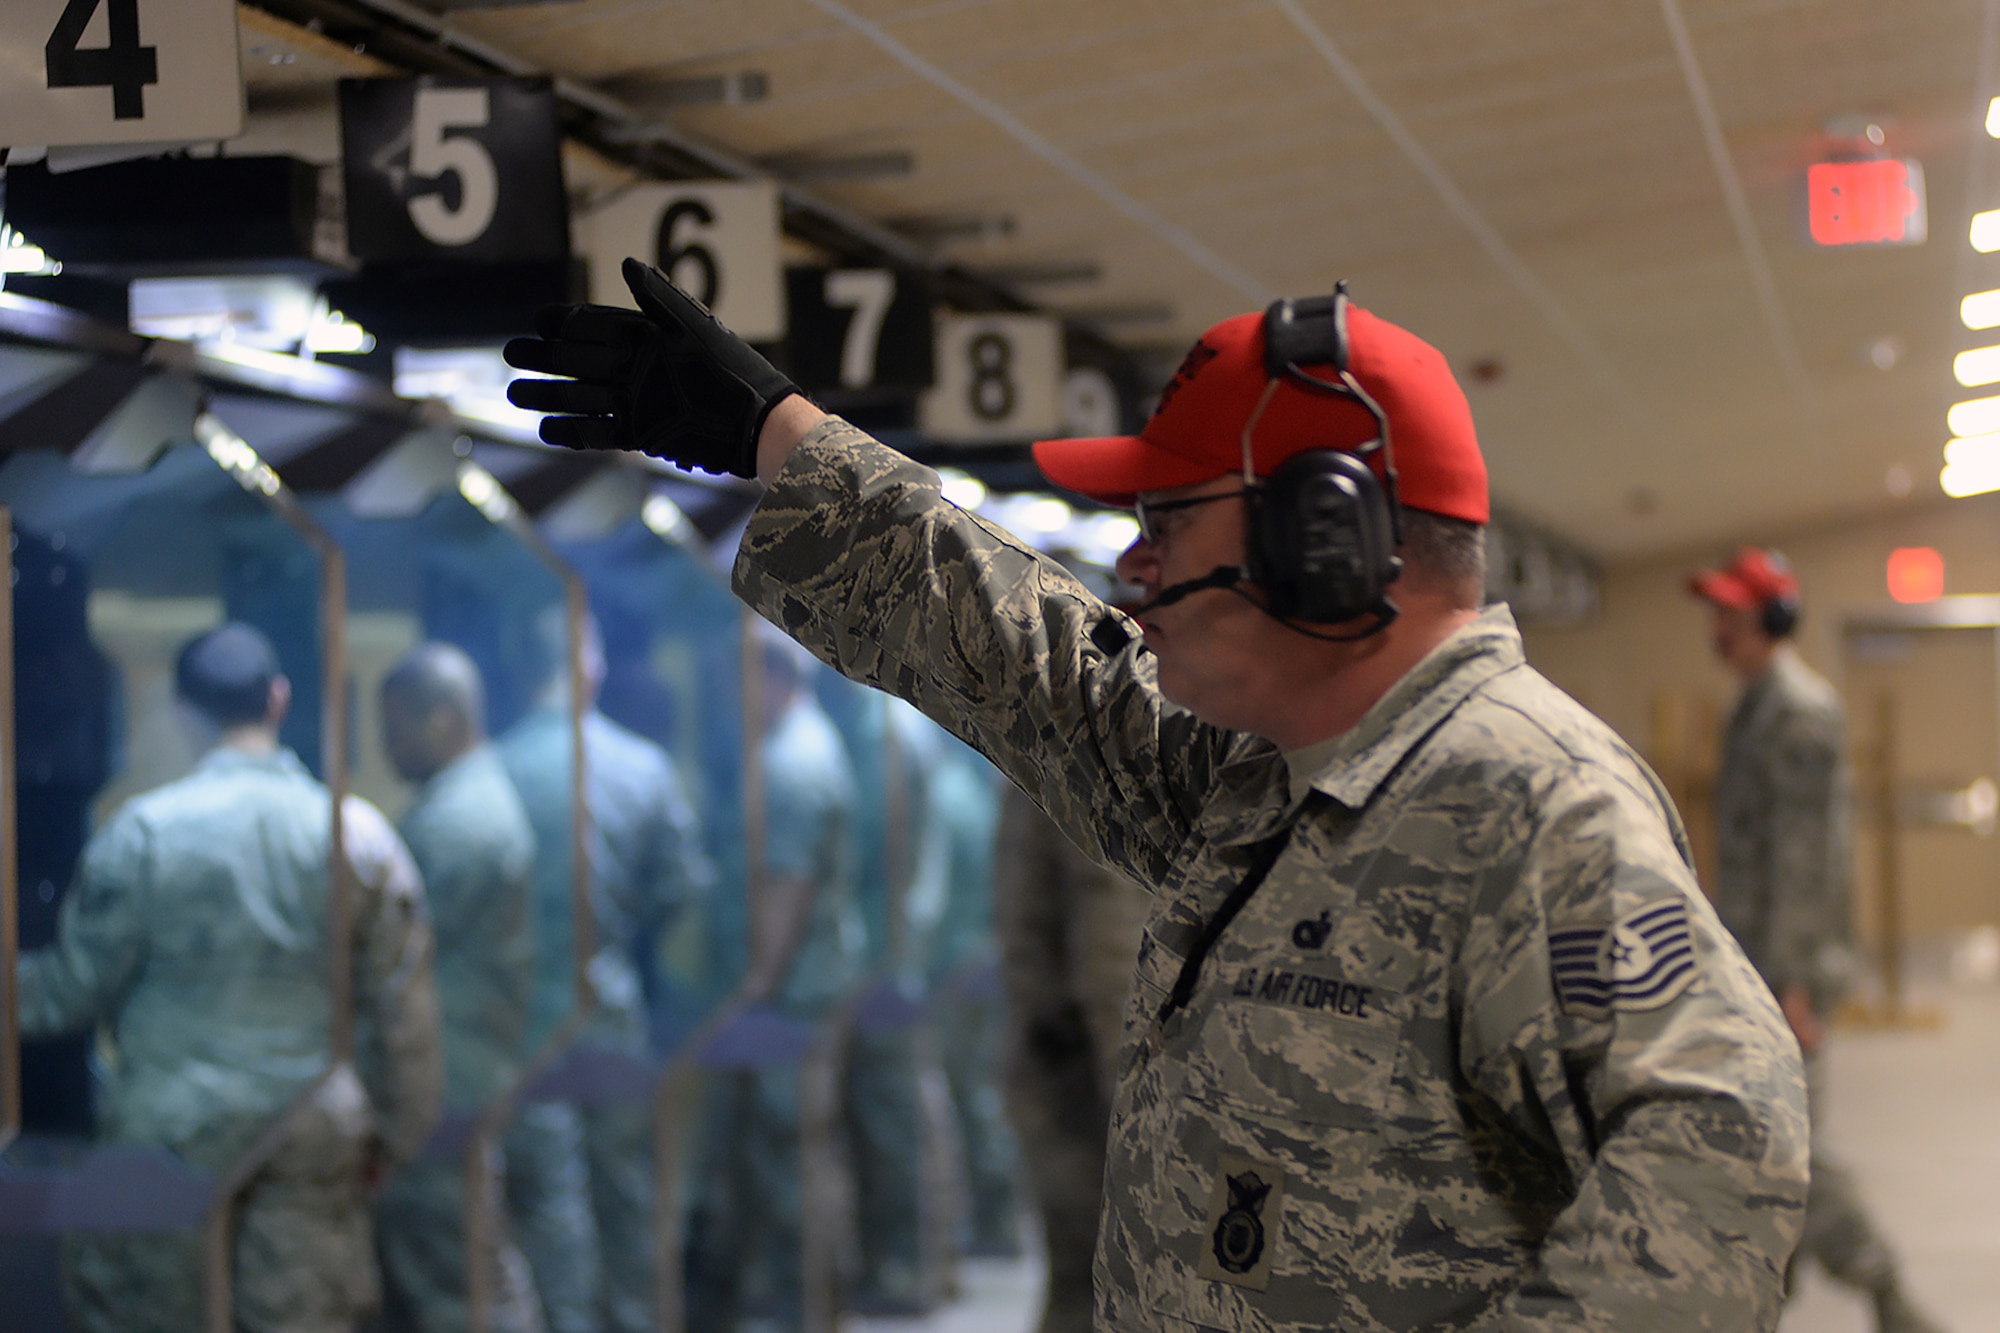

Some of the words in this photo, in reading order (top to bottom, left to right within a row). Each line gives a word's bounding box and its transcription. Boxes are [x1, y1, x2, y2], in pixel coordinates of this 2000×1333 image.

[46, 0, 157, 120] 4
[407, 87, 499, 246] 5
[657, 200, 717, 314] 6
[825, 269, 896, 390] 7
[968, 332, 1015, 421] 8
[1257, 970, 1295, 1004] AIR
[1291, 974, 1373, 1019] FORCE
